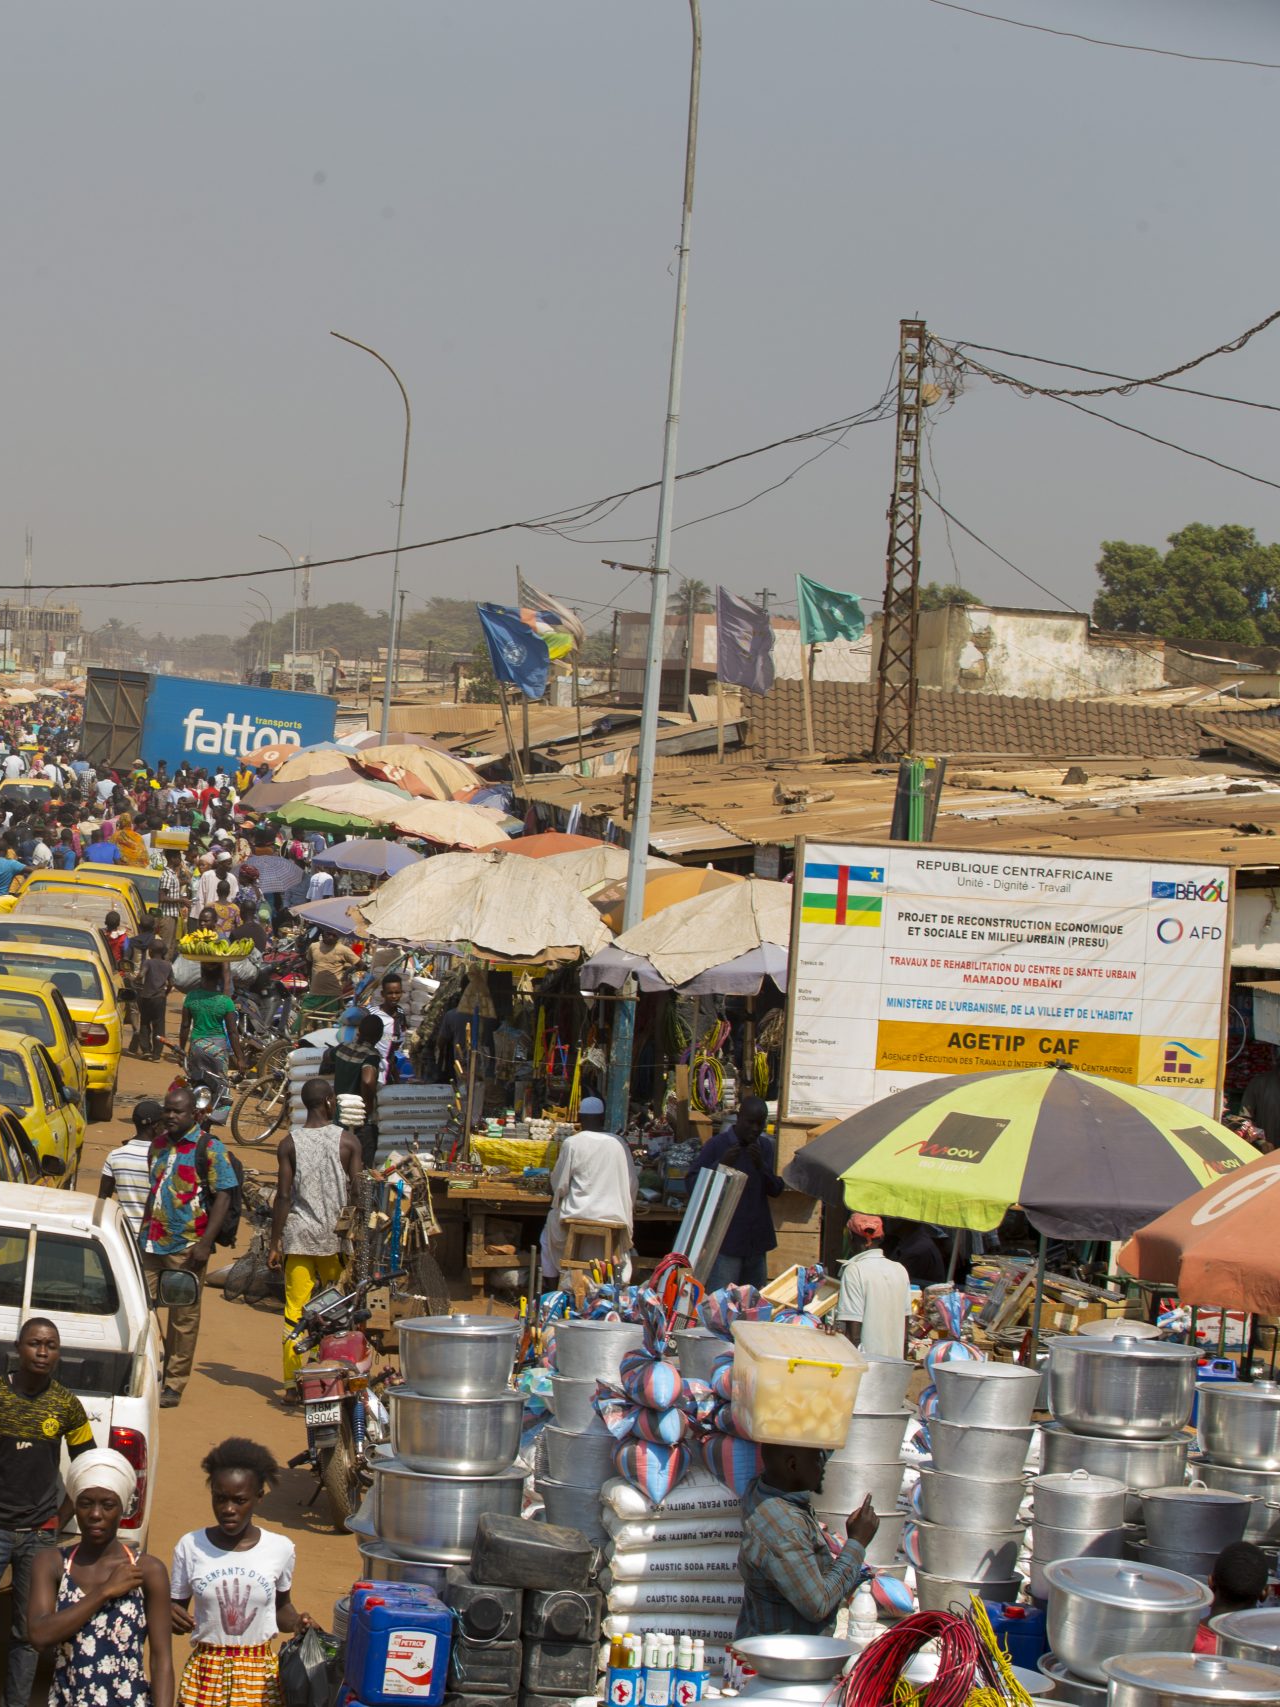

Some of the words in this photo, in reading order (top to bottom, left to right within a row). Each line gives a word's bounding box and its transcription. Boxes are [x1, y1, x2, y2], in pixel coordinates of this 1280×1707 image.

[255, 716, 302, 730] transports
[183, 708, 301, 756] fatton
[916, 860, 999, 875] REPUBLIQUE
[1002, 866, 1113, 882] CENTRAFRICAINE
[957, 876, 984, 889] Unité
[993, 879, 1029, 892] Dignité
[1039, 882, 1072, 893] Travail
[897, 911, 938, 924] PROJET
[940, 914, 954, 925] DE
[957, 915, 1052, 932] RECONSTRUCTION
[1055, 921, 1124, 935] ECONOMIQUE
[907, 926, 920, 936] ET
[923, 927, 968, 939] SOCIALE
[971, 930, 984, 940] EN
[987, 931, 1024, 943] MILIEU
[1026, 934, 1065, 945] URBAIN
[1067, 935, 1109, 950] (PRESU)
[1189, 926, 1222, 940] AFD
[890, 956, 928, 968] TRAVAUX
[930, 959, 941, 969] DE
[943, 959, 1012, 973] REHABILITATION
[1014, 963, 1026, 973] DU
[1028, 964, 1061, 976] CENTRE
[1063, 966, 1074, 976] DE
[1105, 969, 1137, 980] URBAIN
[963, 974, 1020, 986] MAMADOU
[1022, 976, 1063, 989] MBAÏKI
[886, 996, 933, 1010] MINISTÈRE
[935, 1000, 947, 1011] DE
[949, 1001, 1009, 1017] L'URBANISME,
[1010, 1005, 1022, 1016] DE
[1024, 1006, 1035, 1017] LA
[1037, 1007, 1062, 1018] VILLE
[1063, 1008, 1075, 1018] ET
[1077, 1009, 1088, 1019] DE
[1090, 1009, 1134, 1022] L'HABITAT
[947, 1031, 1026, 1052] AGETIP
[1038, 1036, 1080, 1055] CAF
[1154, 1075, 1205, 1085] AGETIP-CAF
[699, 1499, 721, 1510] PEARL
[700, 1530, 722, 1539] PEARL
[724, 1530, 744, 1539] SODA
[649, 1563, 682, 1571] CAUSTIC
[684, 1562, 704, 1571] SODA
[706, 1562, 731, 1571] PEARL
[205, 1567, 246, 1583] ENFANTS
[646, 1595, 678, 1604] CAUSTIC
[680, 1595, 700, 1603] SODA
[702, 1596, 725, 1604] PEARL
